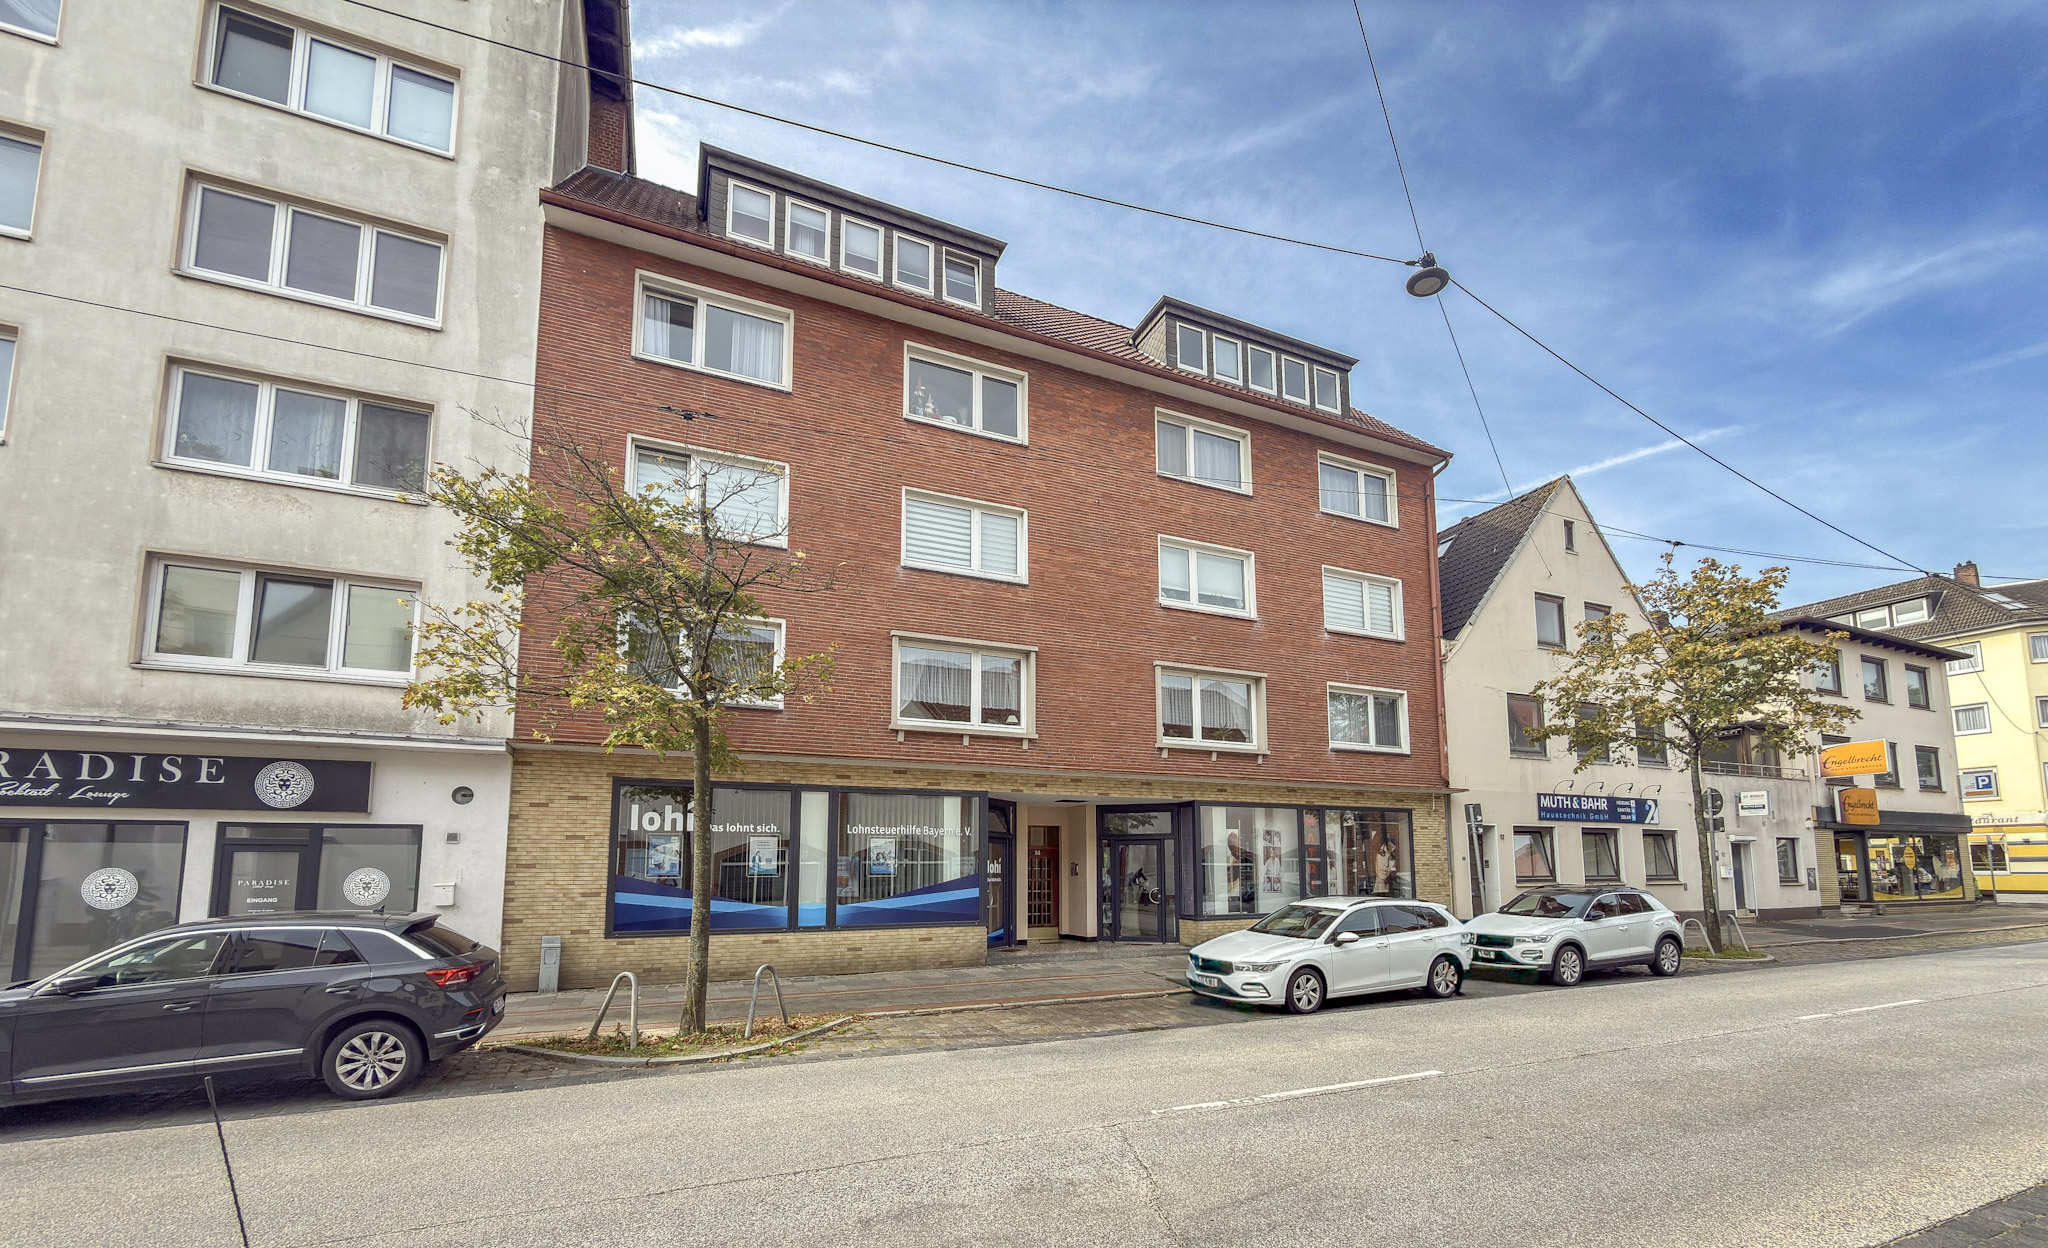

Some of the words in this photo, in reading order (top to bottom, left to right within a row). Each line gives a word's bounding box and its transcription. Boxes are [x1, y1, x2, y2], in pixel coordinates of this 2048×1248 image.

[1822, 754, 1883, 769] Engelbrecht
[1977, 776, 1989, 789] P
[68, 785, 130, 805] Lounge
[1540, 795, 1571, 808] MUTH
[1572, 796, 1580, 809] &
[1581, 797, 1608, 810] BAHR
[1842, 795, 1874, 812] Engelbrecht
[1541, 811, 1587, 819] Haustechnik
[1971, 815, 2019, 825] aurant
[709, 823, 724, 832] as
[726, 823, 755, 832] lohnt
[756, 823, 780, 833] sich.
[847, 823, 921, 836] Lohnsteuerhilfe
[923, 825, 954, 837] Bayern
[955, 828, 963, 836] e.
[964, 826, 972, 836] V.
